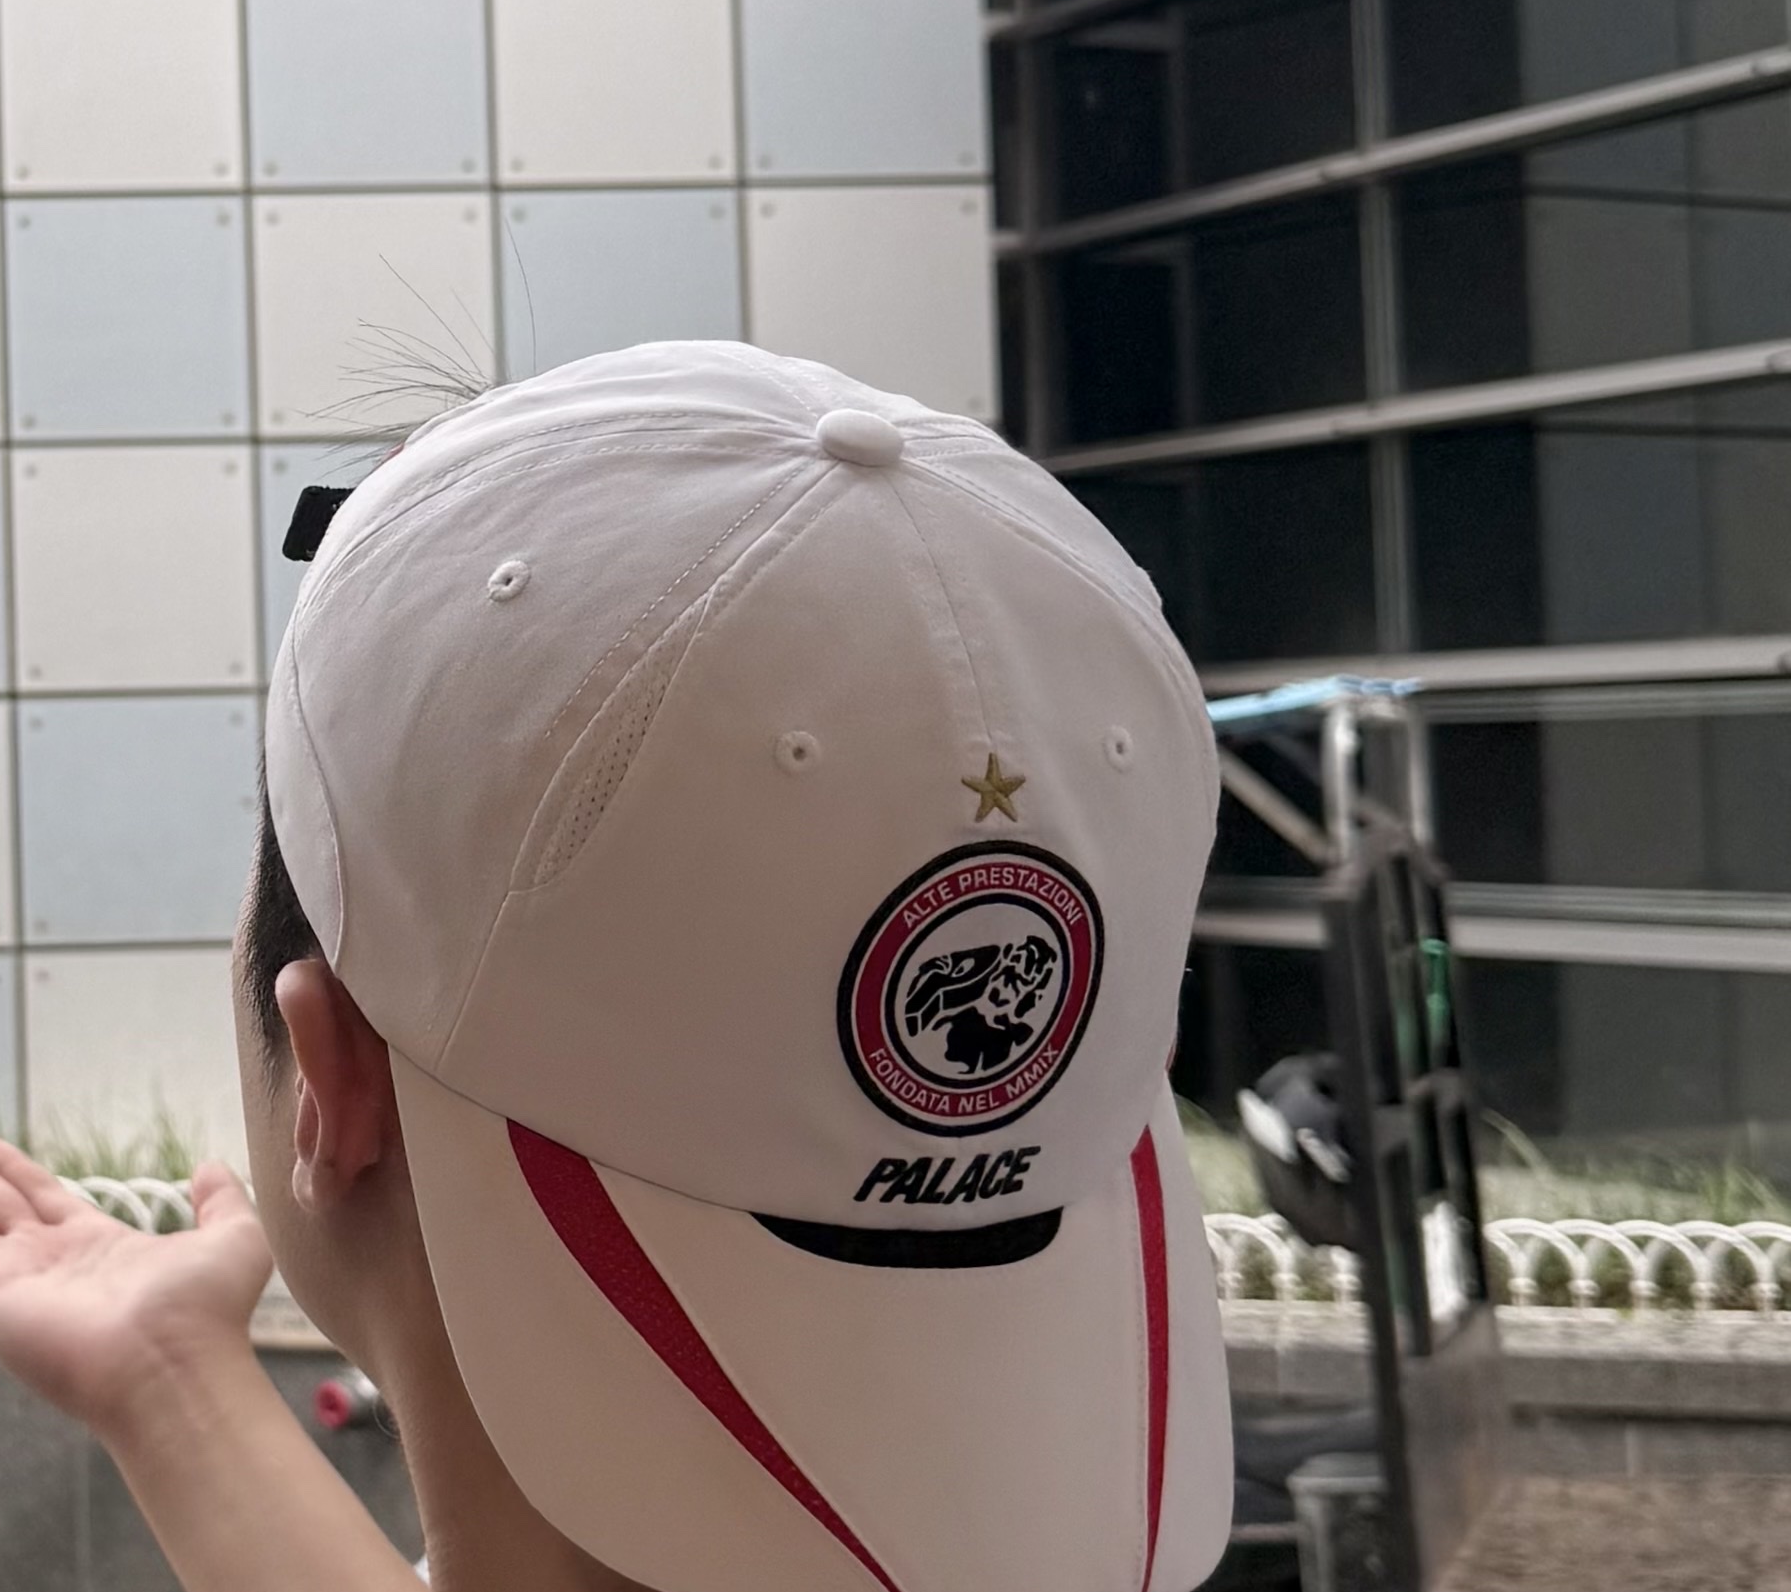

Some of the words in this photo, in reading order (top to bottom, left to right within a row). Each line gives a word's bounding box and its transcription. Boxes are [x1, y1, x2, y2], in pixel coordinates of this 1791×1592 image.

[902, 882, 954, 928] ALTE
[959, 866, 1084, 925] PRESTAZIONI
[869, 1047, 951, 1114] FONDATA
[958, 1089, 1000, 1114] NEL
[1005, 1043, 1060, 1099] MMIX
[853, 1145, 1042, 1205] PALACE
